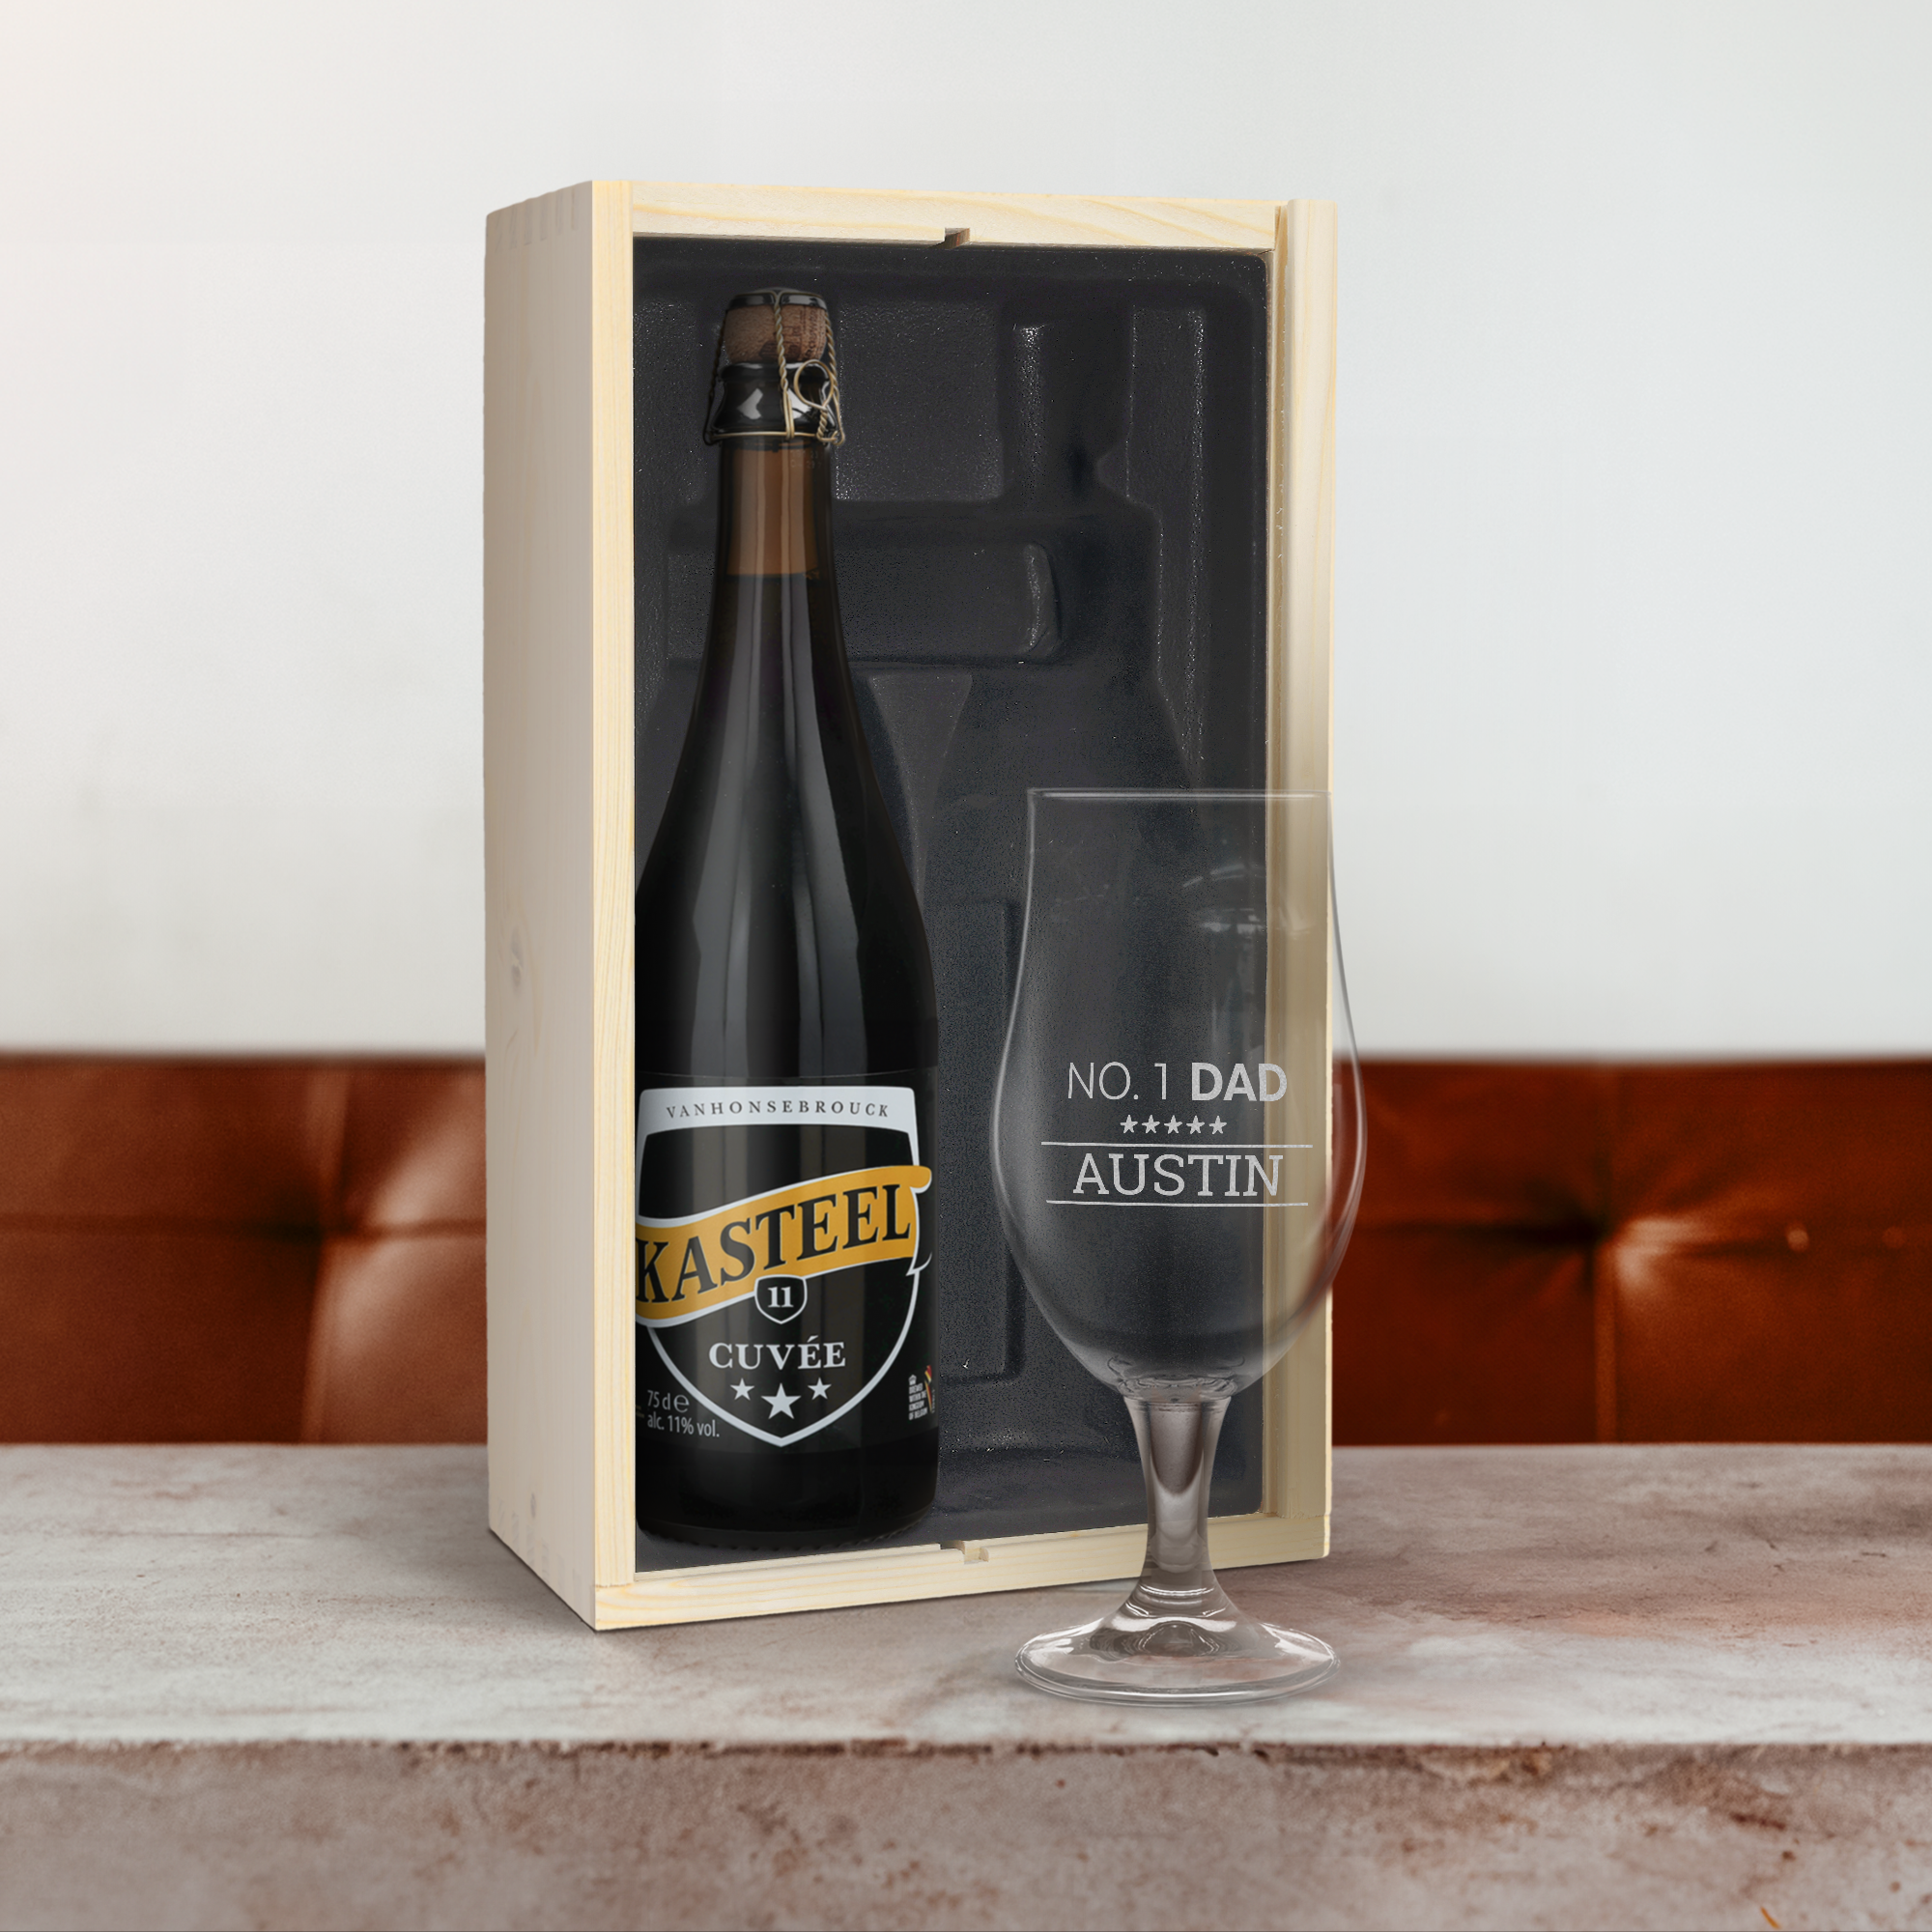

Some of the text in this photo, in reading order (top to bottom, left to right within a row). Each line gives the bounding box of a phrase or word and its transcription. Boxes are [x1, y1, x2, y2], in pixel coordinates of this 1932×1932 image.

[1067, 1061, 1288, 1102] NO. 1 DAD
[667, 1099, 890, 1119] VANHONSEBROUCK
[1072, 1152, 1284, 1197] AUSTIN
[636, 1183, 911, 1304] KASTEEL
[767, 1286, 792, 1309] 11
[708, 1335, 846, 1371] CUVÉE
[647, 1410, 665, 1431] alc.
[668, 1414, 695, 1435] 11%
[696, 1419, 721, 1438] vol.
